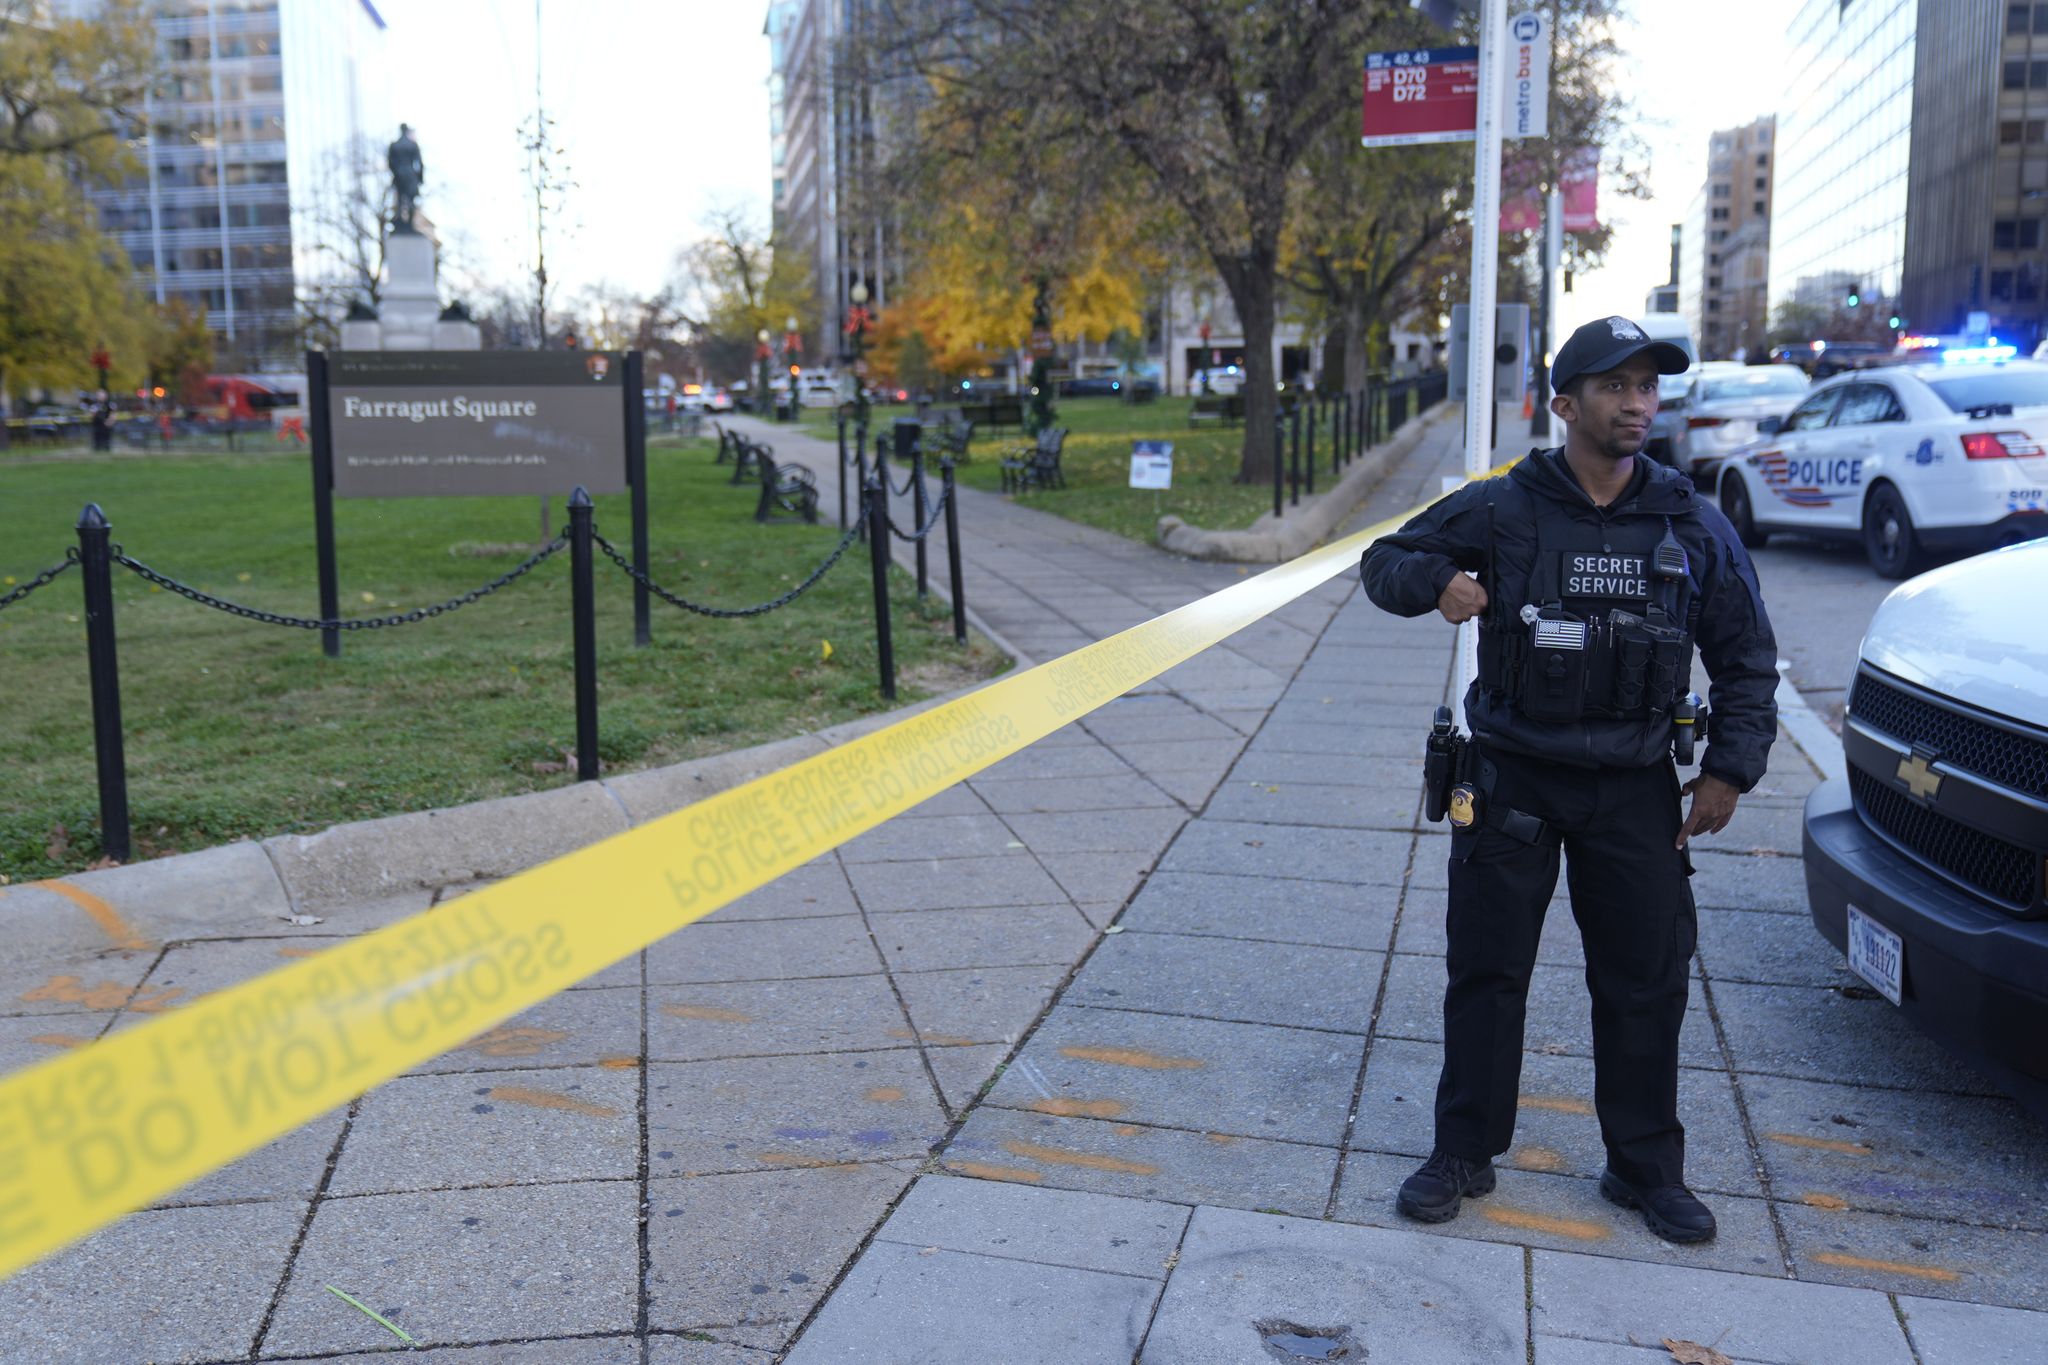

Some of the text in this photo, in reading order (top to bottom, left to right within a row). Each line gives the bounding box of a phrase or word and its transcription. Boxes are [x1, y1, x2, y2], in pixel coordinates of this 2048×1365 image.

[1414, 50, 1429, 64] 43
[1394, 67, 1426, 84] D70
[1393, 84, 1426, 102] D72
[1516, 45, 1531, 134] metrobus
[344, 396, 536, 422] Farragut Square
[1788, 459, 1863, 487] POLICE
[1573, 557, 1644, 575] SECRET
[1569, 577, 1647, 596] SERVICE
